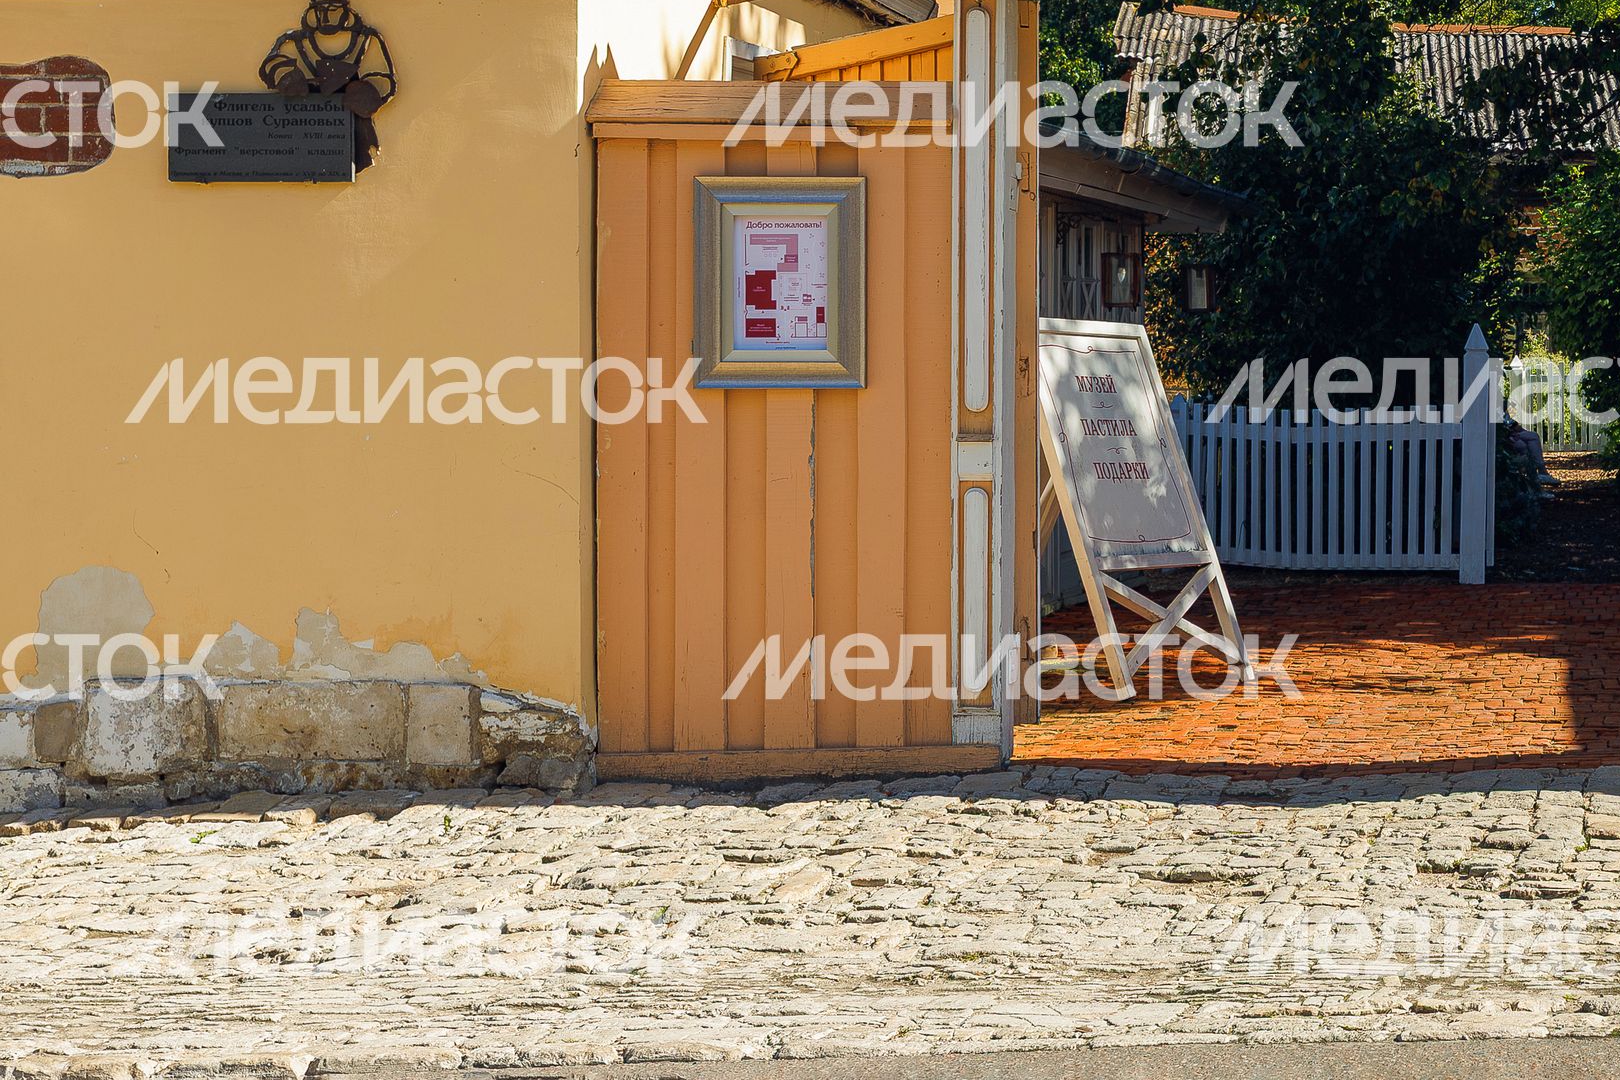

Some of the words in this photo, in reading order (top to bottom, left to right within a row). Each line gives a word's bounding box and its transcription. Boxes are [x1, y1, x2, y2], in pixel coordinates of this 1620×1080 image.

[214, 99, 275, 114] Флигель
[262, 114, 345, 130] Сурановых
[746, 220, 773, 230] Добро
[774, 221, 823, 230] пожаловать!
[1074, 373, 1117, 394] МУЗЕЙ
[1079, 417, 1138, 437] ПАСТИЛА
[1092, 461, 1150, 483] ПОДАРКИ
